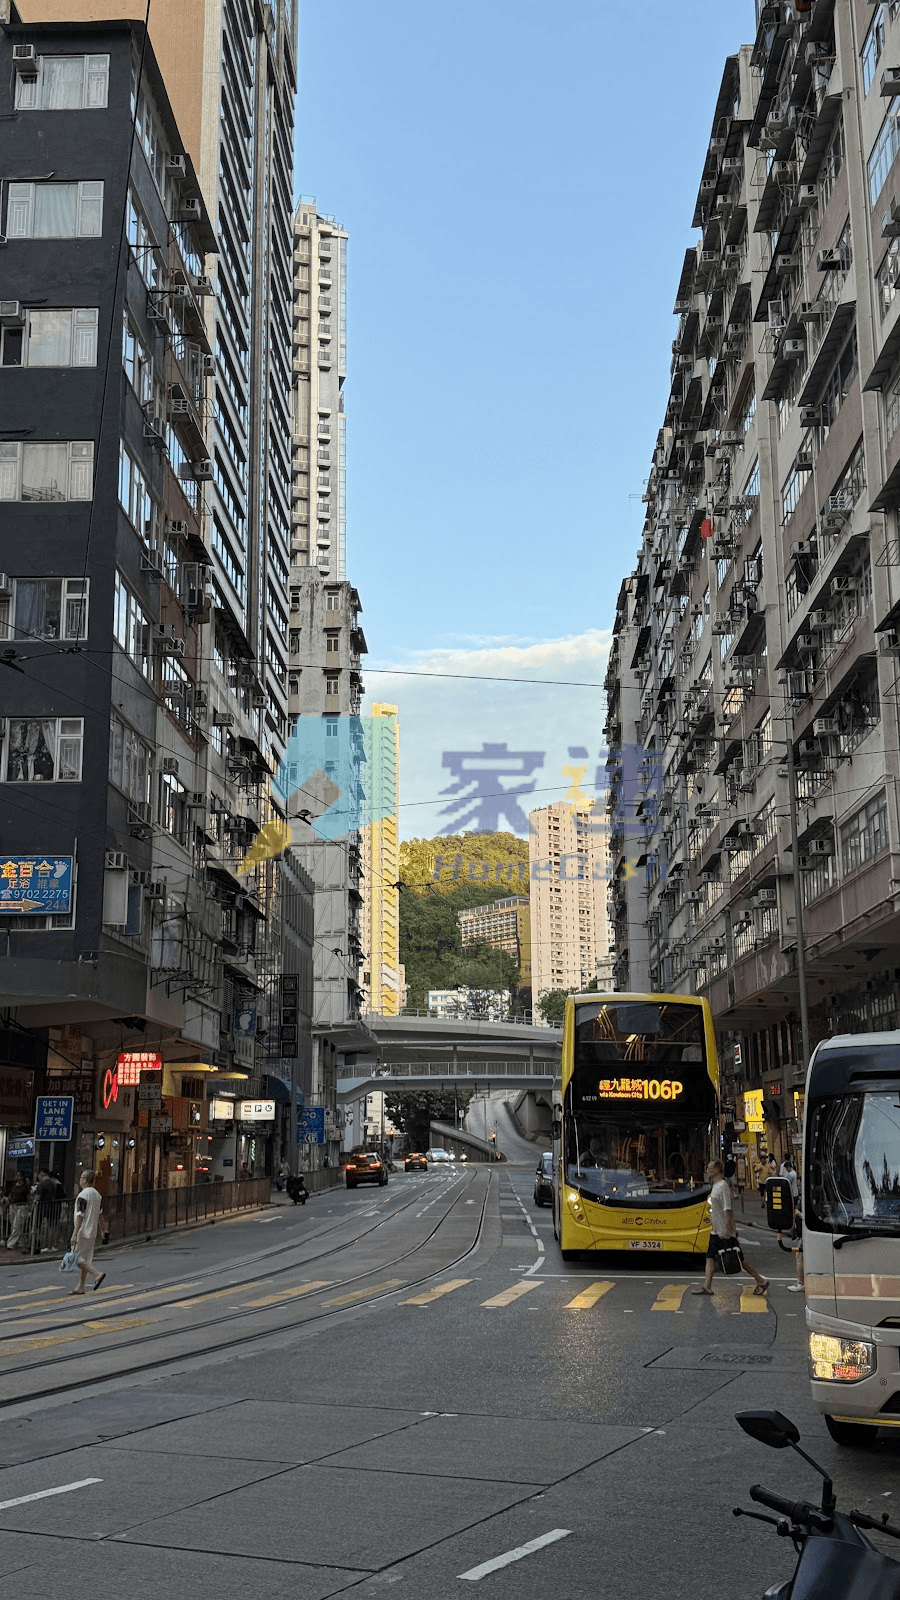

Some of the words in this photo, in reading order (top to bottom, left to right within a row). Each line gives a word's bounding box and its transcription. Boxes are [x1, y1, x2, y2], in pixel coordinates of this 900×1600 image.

[0, 860, 54, 878] 金百合
[7, 879, 30, 889] 足浴
[14, 890, 39, 899] 9702
[42, 890, 68, 899] 2275
[599, 1078, 642, 1091] 經九龍城
[642, 1079, 683, 1100] 106P
[43, 1117, 64, 1126] 選定
